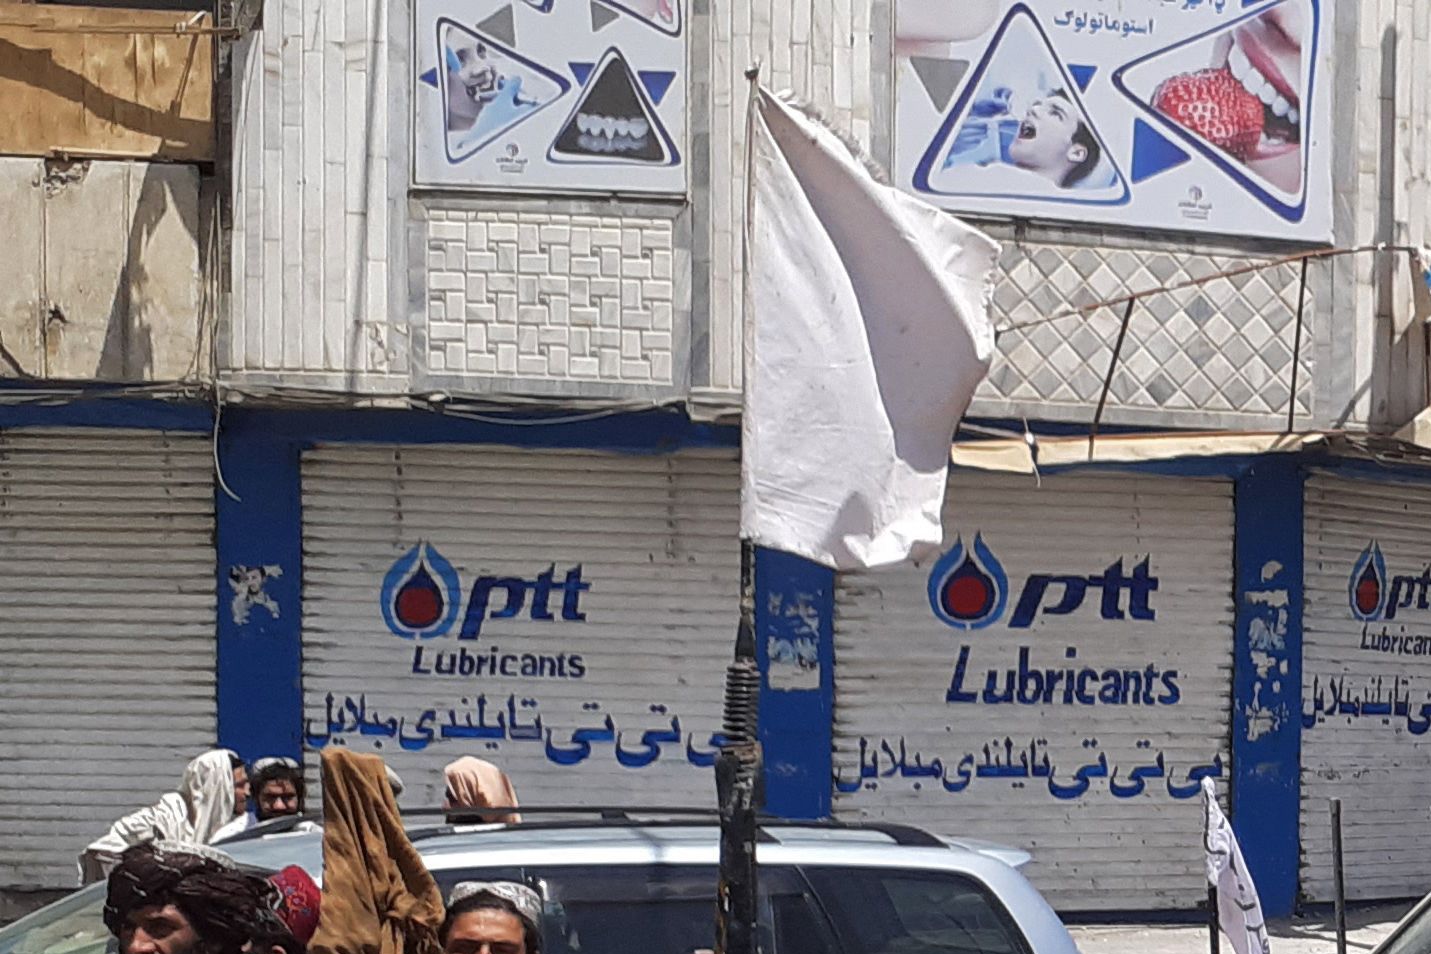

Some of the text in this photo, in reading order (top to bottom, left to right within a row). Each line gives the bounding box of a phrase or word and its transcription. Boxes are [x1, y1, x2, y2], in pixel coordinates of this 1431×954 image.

[458, 561, 592, 641] ptt
[1007, 552, 1160, 629] ptt
[412, 645, 587, 680] Lubricants
[944, 645, 1181, 706] Lubricants
